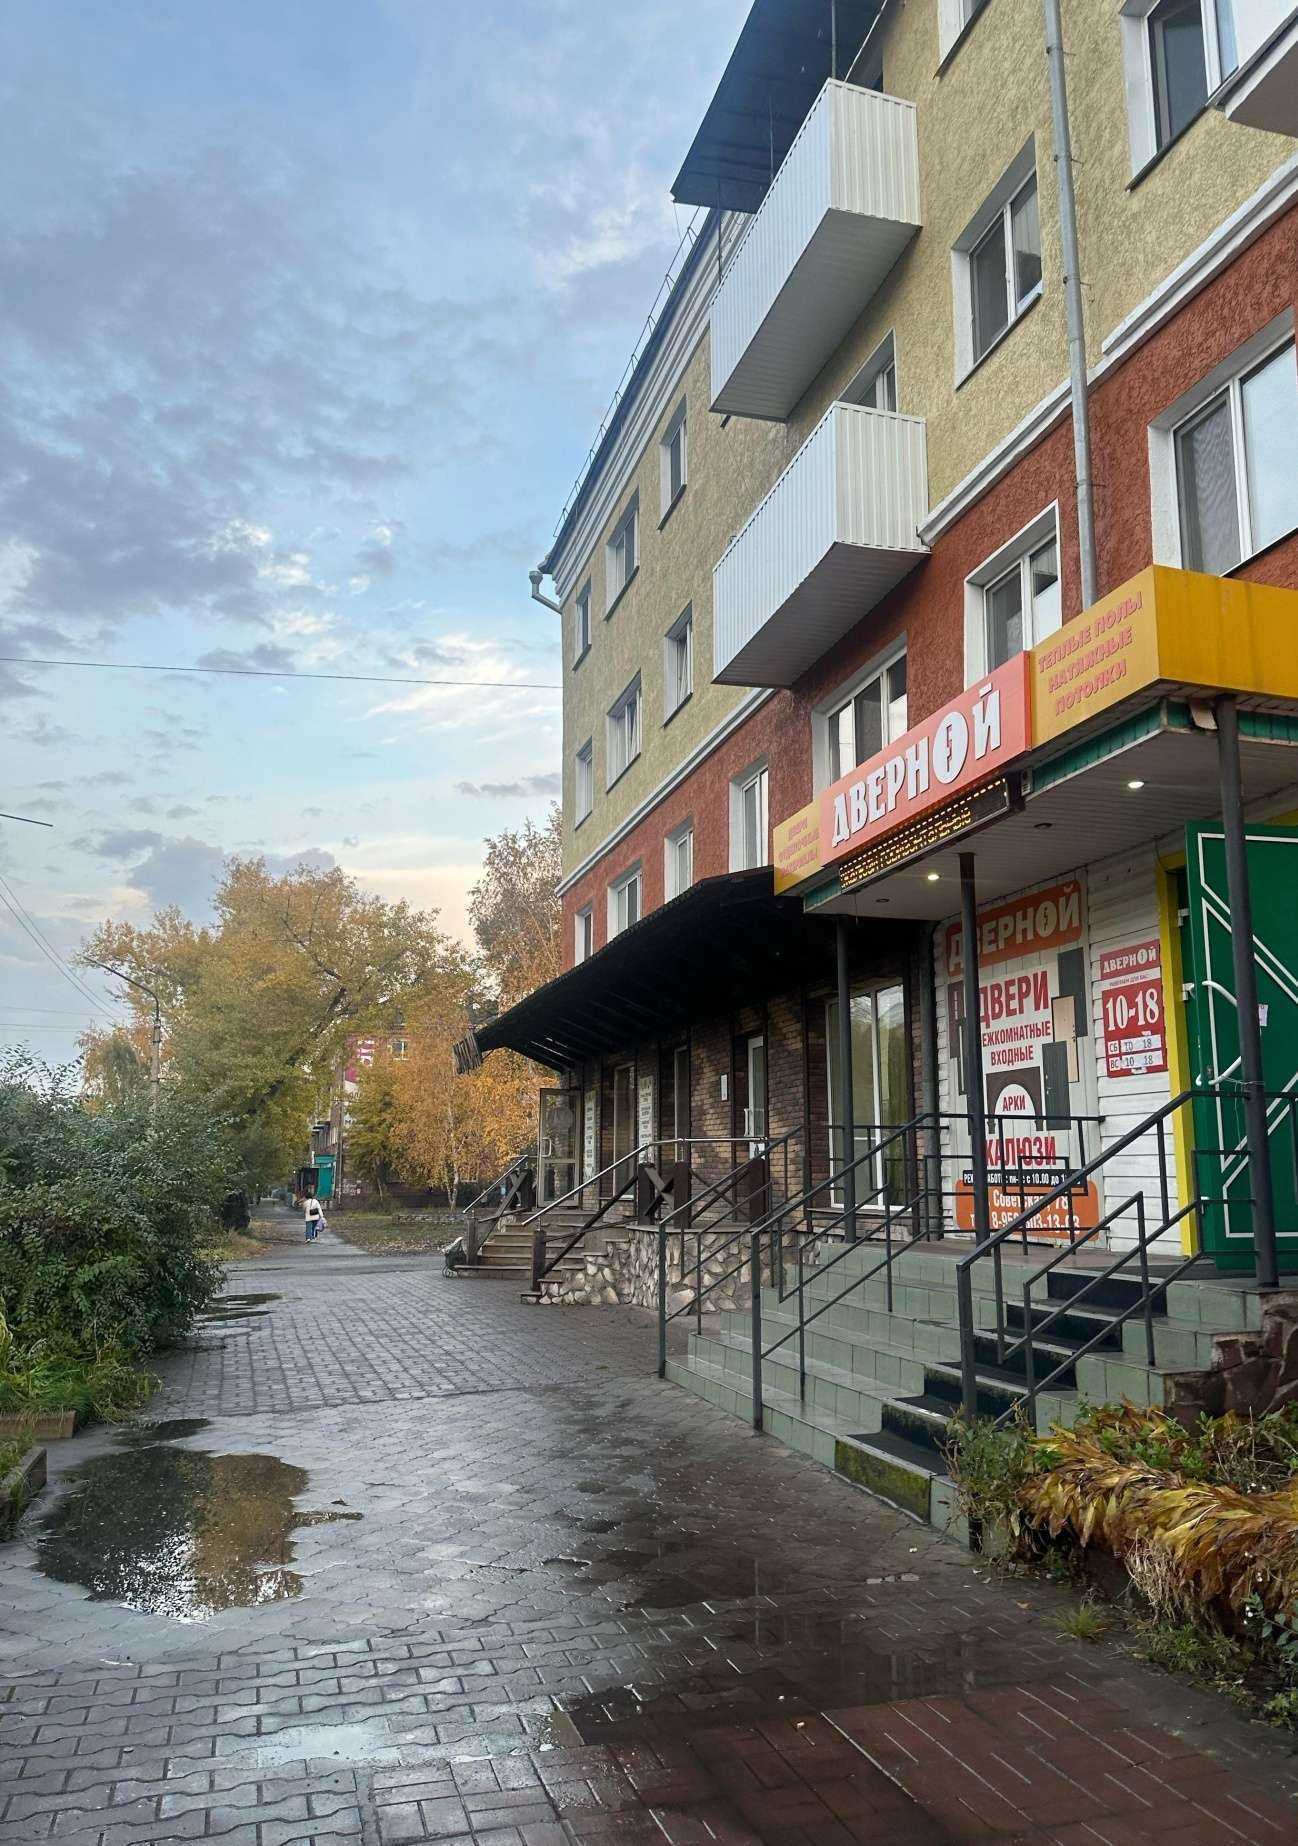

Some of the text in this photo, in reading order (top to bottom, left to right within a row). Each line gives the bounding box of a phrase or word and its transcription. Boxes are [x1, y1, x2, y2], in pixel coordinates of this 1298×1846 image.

[1038, 591, 1142, 673] ТЕПЛЫЕ ПОЛЫ
[1049, 626, 1133, 694] НАТЯЖНЫЕ
[1056, 658, 1127, 717] ПОТОЛКИ
[831, 683, 1001, 848] ДВЕРНОЙ
[949, 884, 1080, 972] ДЕРНОЙ
[1103, 946, 1157, 974] ДВЕРНОЙ
[1105, 988, 1160, 1031] 10-18
[982, 1020, 1051, 1048] ЕЖКОМНАТНЫЕ
[1143, 1038, 1152, 1049] 18
[990, 1045, 1034, 1067] ВХОДНЫЕ
[1002, 1094, 1026, 1112] АРКИ
